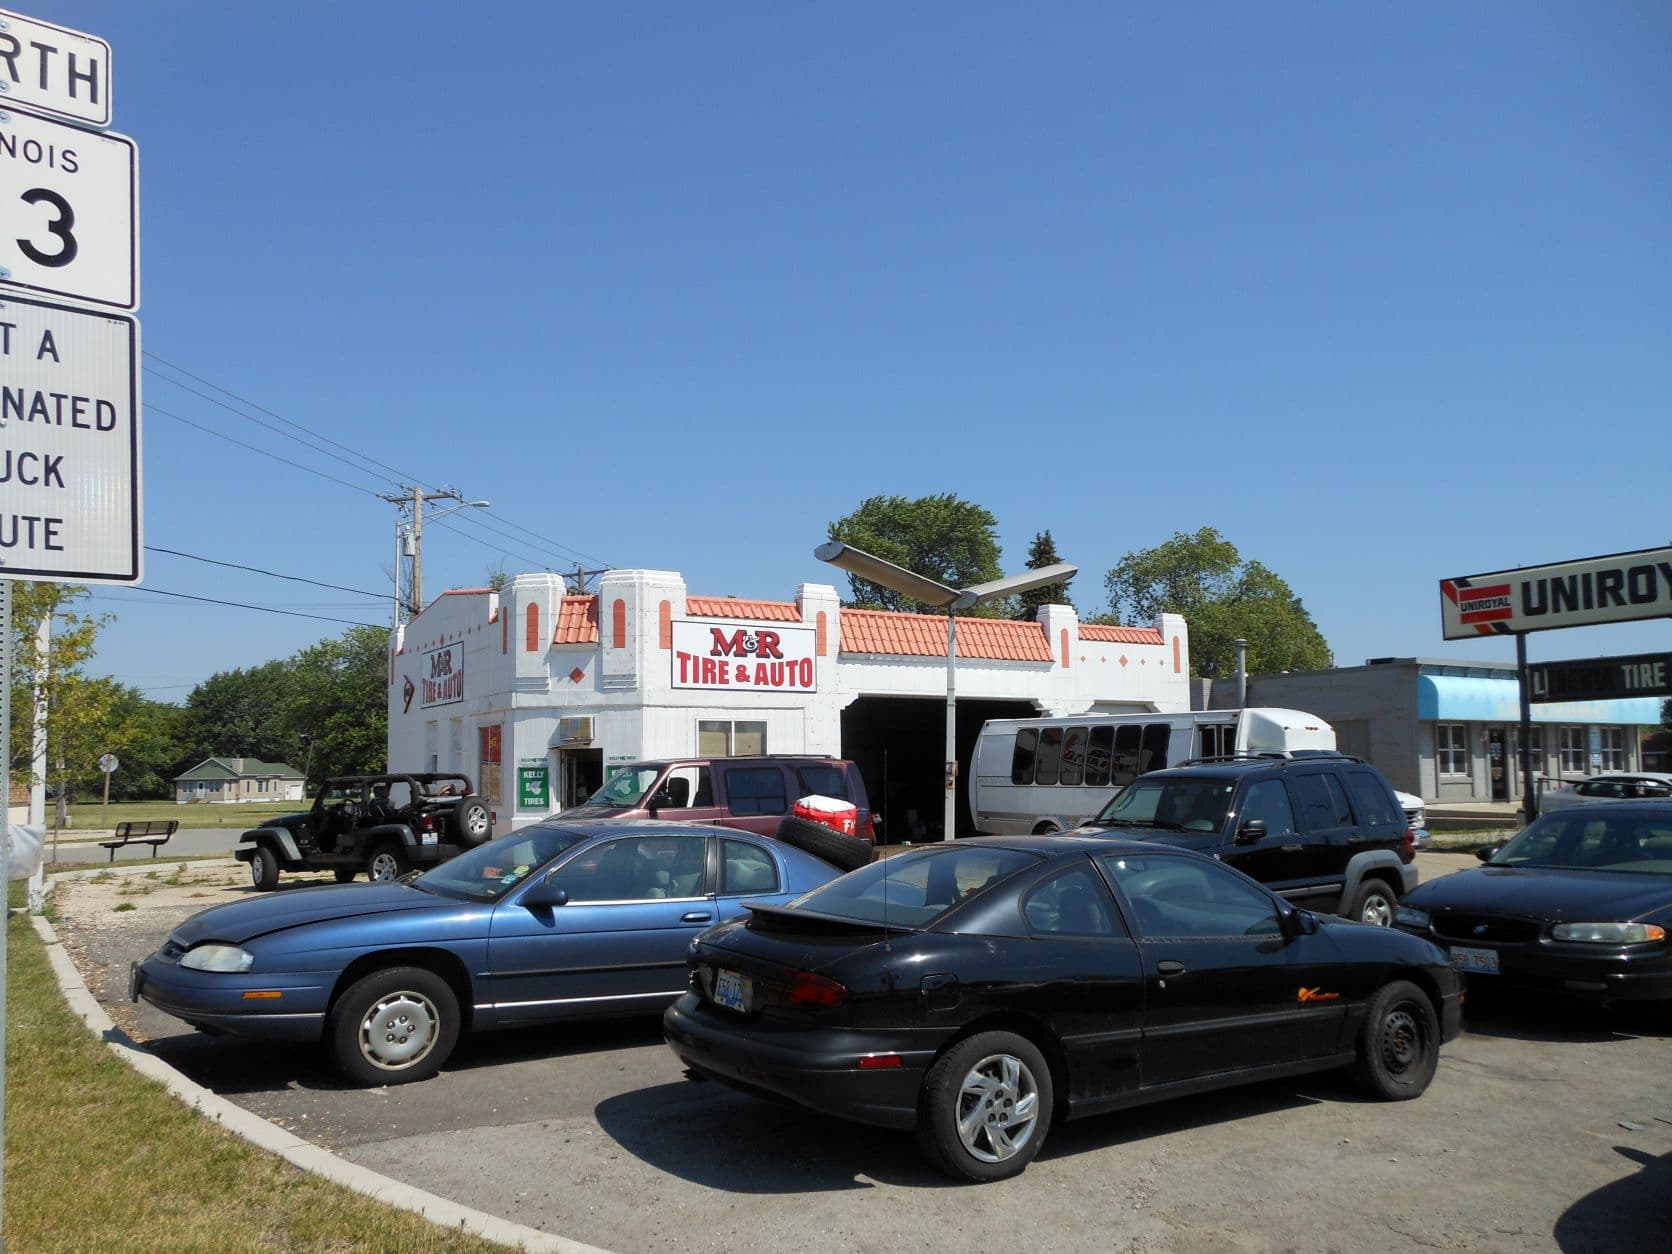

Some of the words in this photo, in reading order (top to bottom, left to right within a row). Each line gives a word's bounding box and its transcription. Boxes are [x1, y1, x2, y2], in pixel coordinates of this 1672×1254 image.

[16, 187, 78, 269] 3
[37, 329, 61, 363] A
[2, 385, 117, 433] NATED
[0, 514, 65, 552] UTE
[1460, 596, 1511, 612] UNIROYAL
[709, 627, 784, 660] M&R
[676, 650, 730, 685] TIRE
[735, 664, 751, 683] &
[753, 657, 813, 688] AUTO
[1621, 662, 1666, 689] TIRE
[421, 677, 437, 705] TIRE
[443, 668, 462, 701] AUTO
[523, 770, 545, 779] KELLY
[523, 797, 545, 806] TIRES
